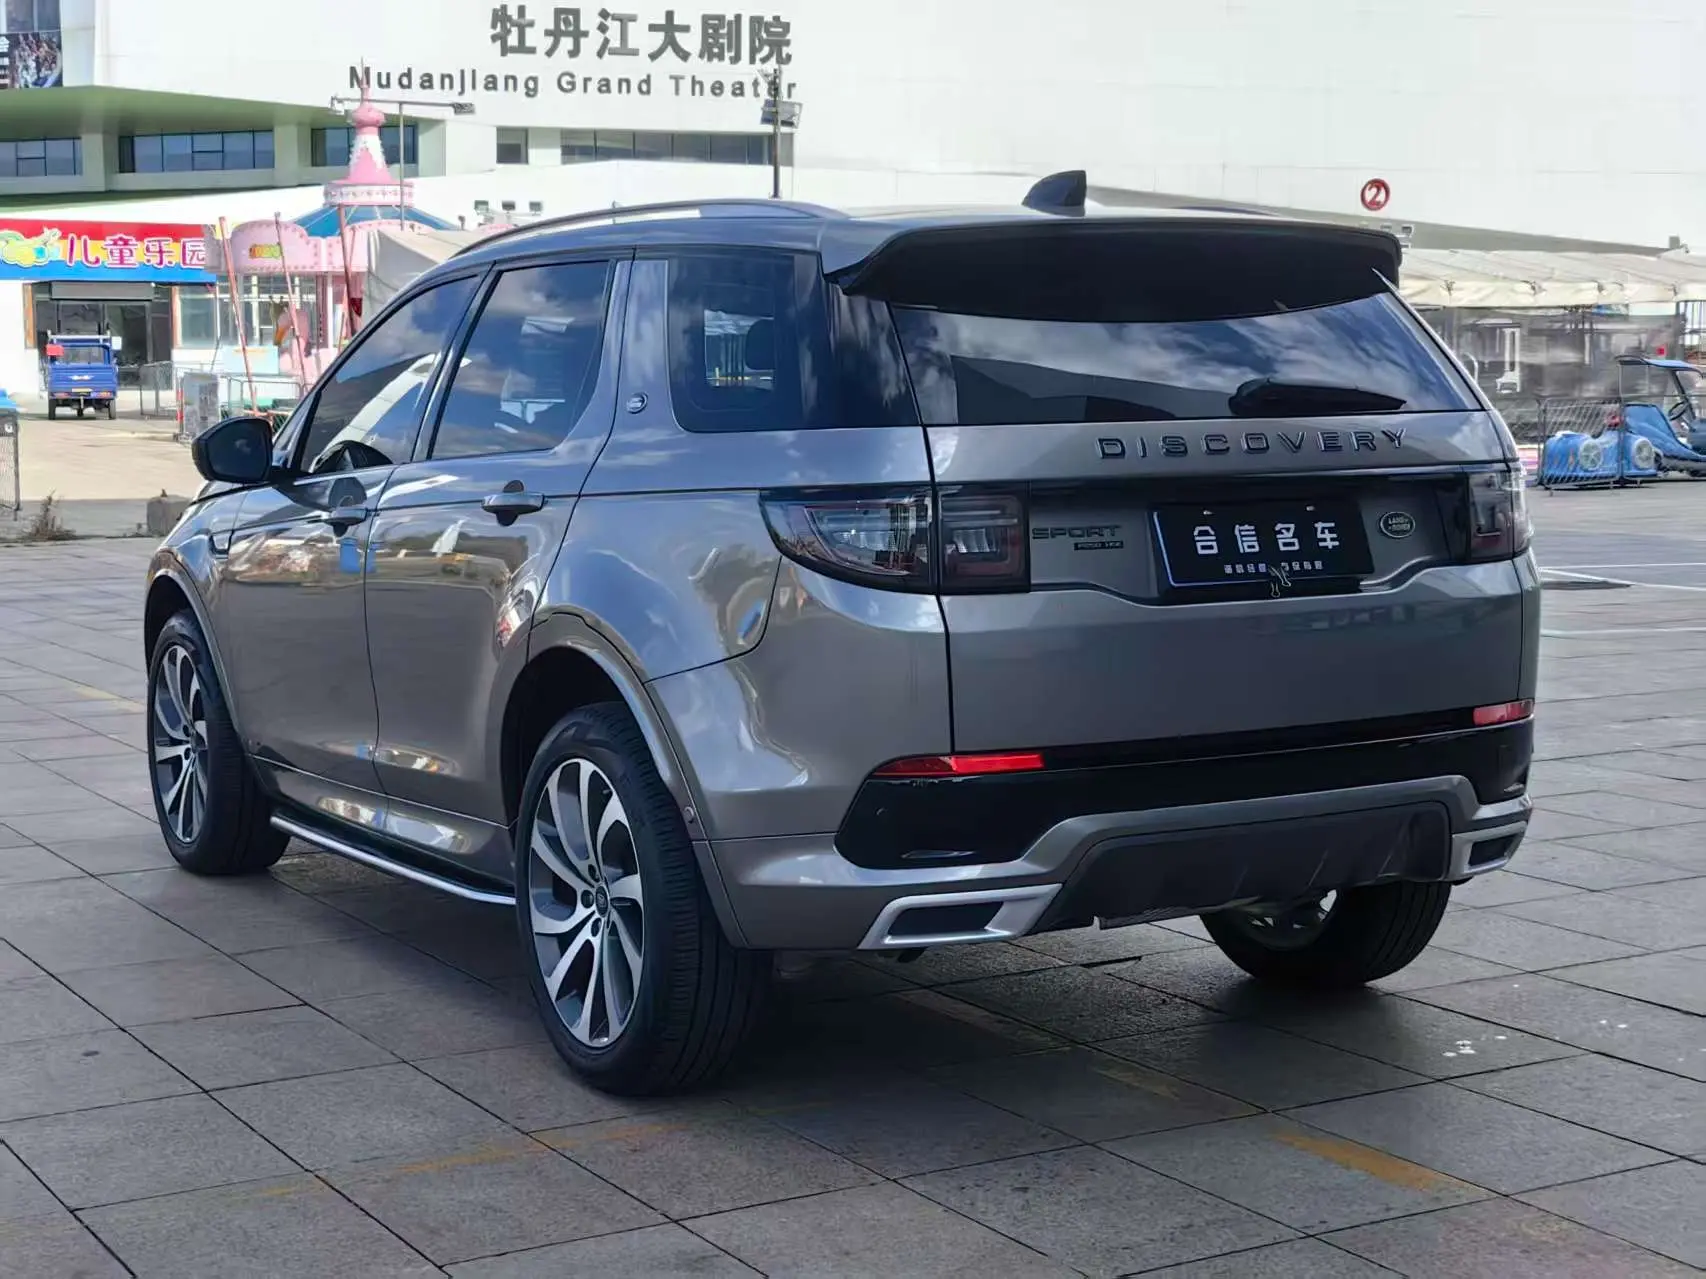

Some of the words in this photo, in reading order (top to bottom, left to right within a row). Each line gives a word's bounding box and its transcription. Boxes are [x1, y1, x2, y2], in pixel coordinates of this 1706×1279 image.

[490, 5, 793, 66] 牡丹江大剧院
[557, 71, 651, 97] Grand
[67, 234, 205, 267] 儿童乐园
[1096, 428, 1406, 459] DISCOVERY
[1032, 524, 1122, 540] SPORT
[1193, 521, 1340, 555] 合信名车
